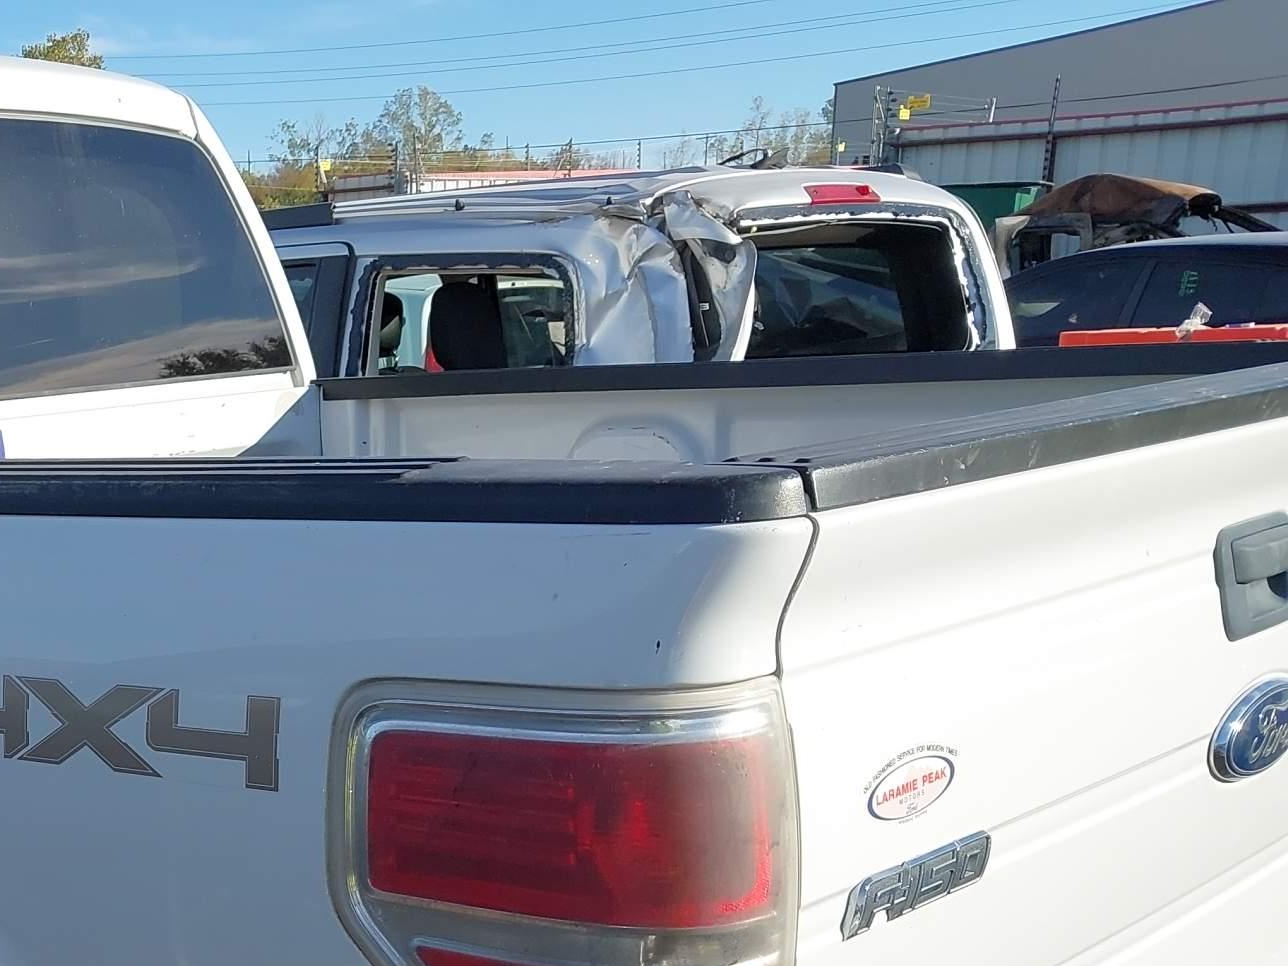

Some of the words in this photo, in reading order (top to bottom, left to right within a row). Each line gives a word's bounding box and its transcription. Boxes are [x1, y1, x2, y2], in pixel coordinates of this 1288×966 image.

[876, 778, 918, 806] LARAMIE
[921, 766, 948, 787] PEAK
[899, 788, 926, 805] MOTORS
